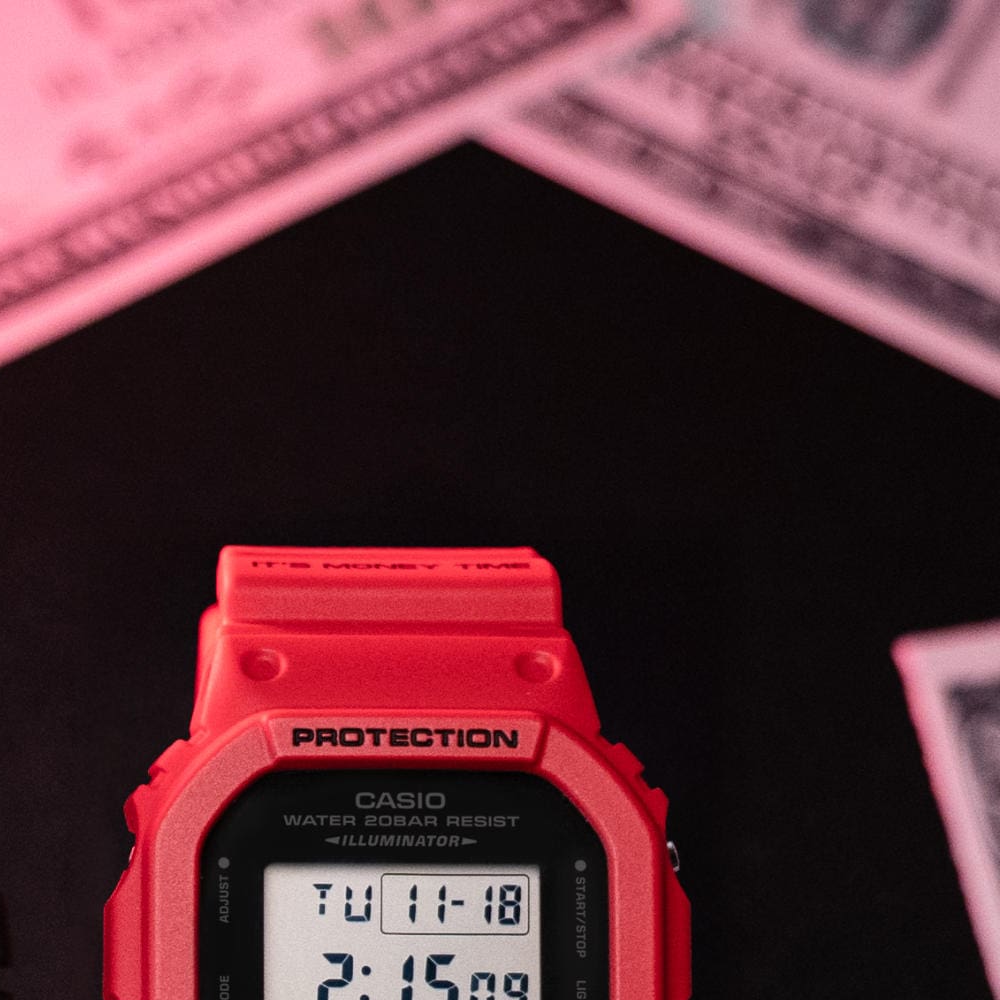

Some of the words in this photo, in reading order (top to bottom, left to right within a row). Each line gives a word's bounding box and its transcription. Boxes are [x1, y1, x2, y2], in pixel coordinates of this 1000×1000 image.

[453, 562, 531, 571] TIME
[292, 727, 519, 748] PROTECTION
[355, 792, 446, 810] CASIO
[283, 814, 356, 828] WATER
[364, 814, 438, 828] 20BAR
[446, 815, 520, 828] RESIST
[341, 834, 461, 848] ILLUMINATOR
[219, 874, 230, 924] ADJUST
[312, 883, 373, 923] TU
[408, 883, 523, 926] 11-18
[575, 876, 587, 959] START/STOP
